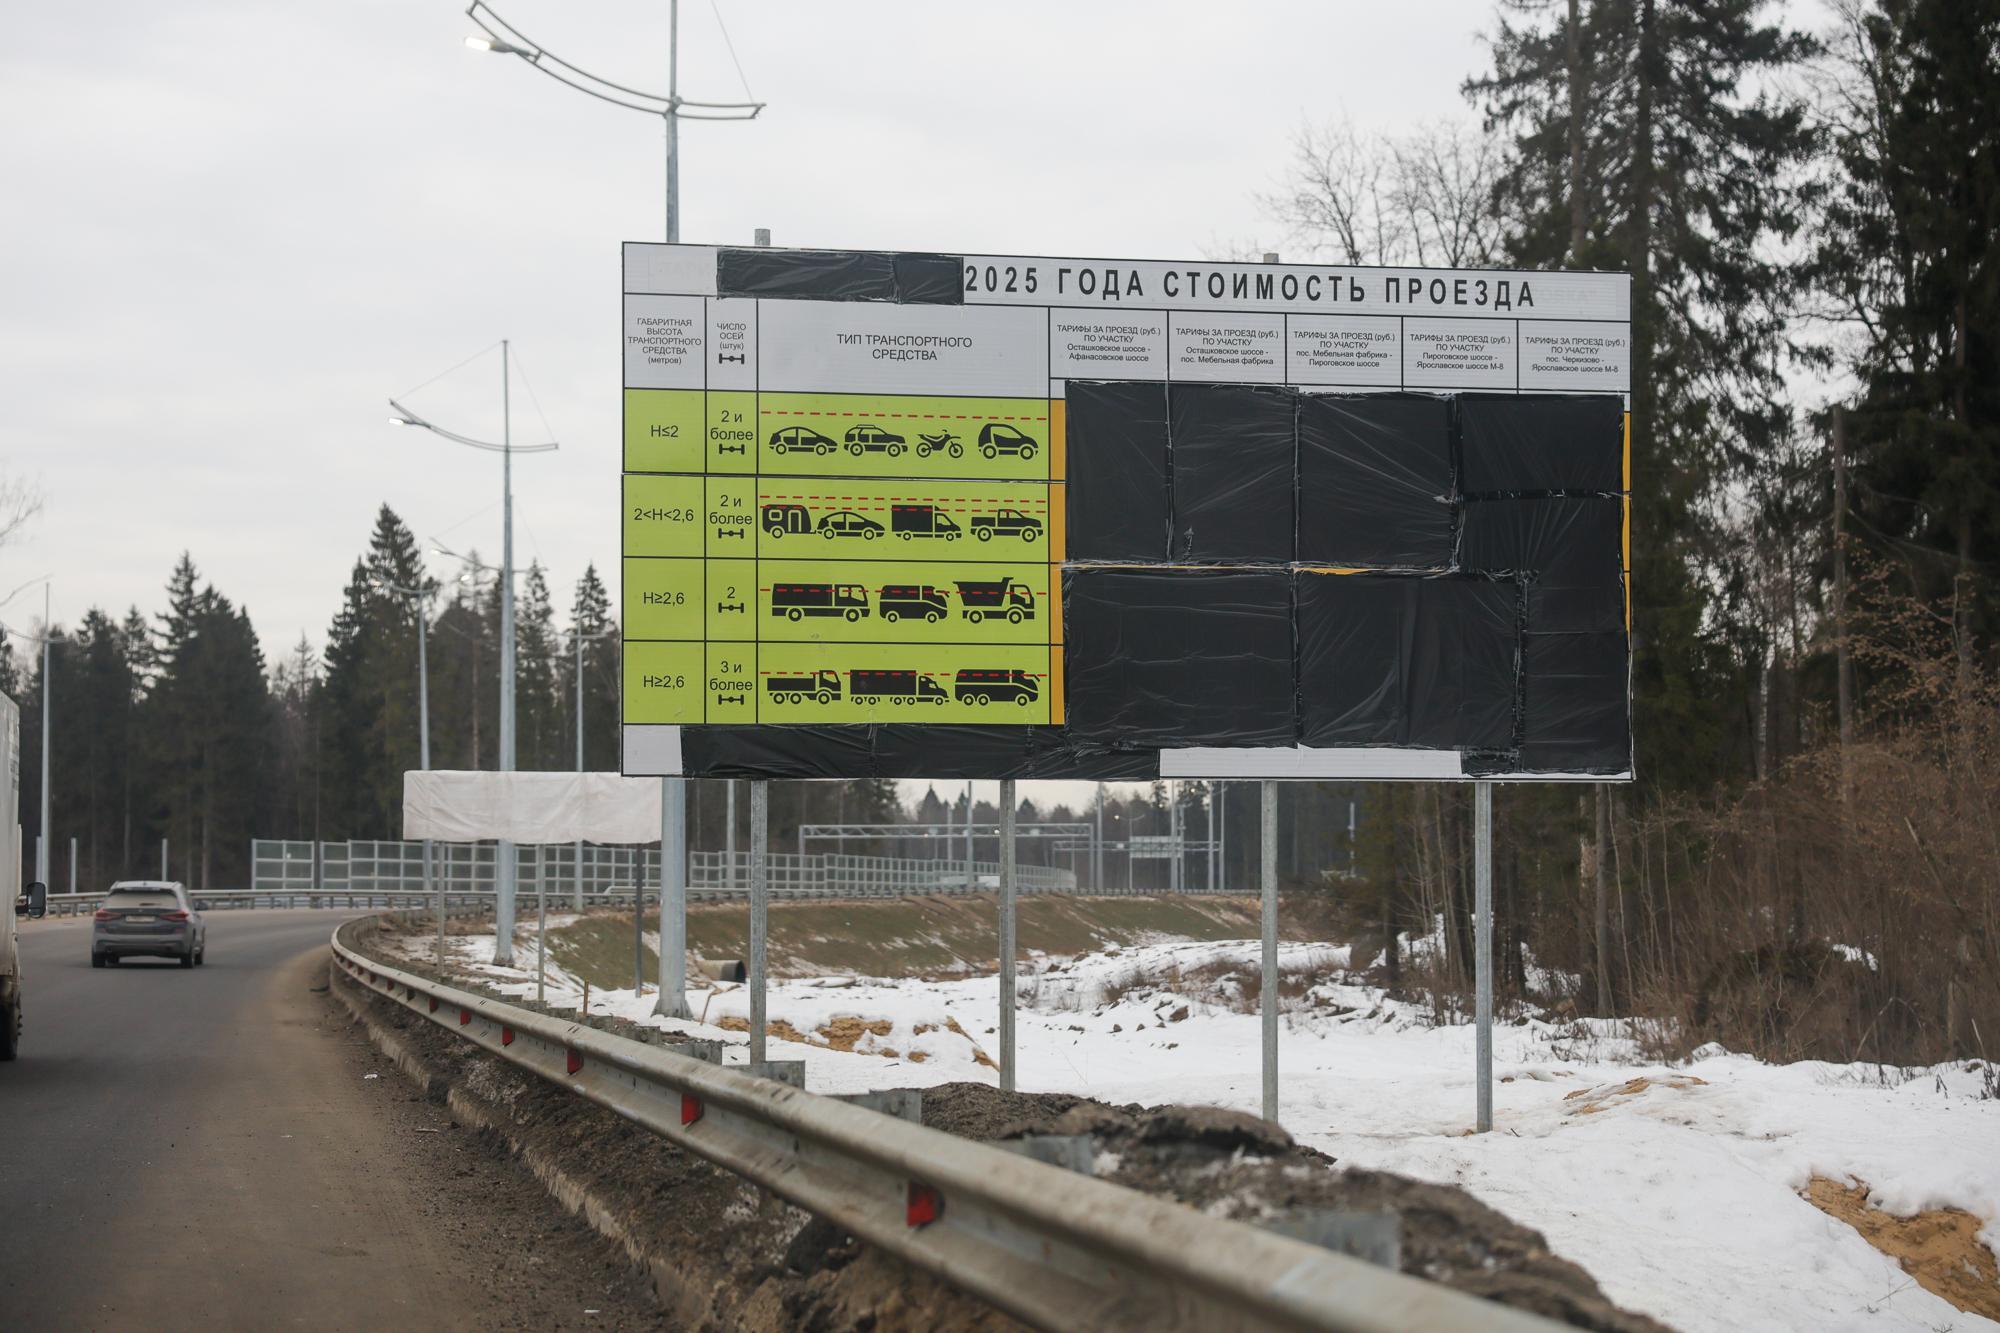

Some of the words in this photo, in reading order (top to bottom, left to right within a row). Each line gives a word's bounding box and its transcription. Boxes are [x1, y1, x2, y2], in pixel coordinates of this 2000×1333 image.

[965, 266, 1038, 293] 2025
[1058, 268, 1144, 301] ГОДА
[1163, 271, 1366, 302] СТОИМОСТЬ
[1385, 276, 1535, 310] ПРОЕЗДА
[637, 318, 692, 327] ГАБАРИТНАЯ
[717, 323, 746, 331] ЧИСЛО
[647, 327, 683, 336] ВЫСОТА
[1057, 325, 1091, 333] ТАРИФЫ
[1106, 326, 1138, 334] ПРОЕЗД
[1140, 327, 1160, 336] (руб.)
[1176, 328, 1210, 336] ТАРИФЫ
[1224, 330, 1256, 338] ПРОЕЗД
[1258, 331, 1279, 339] (руб.)
[720, 331, 743, 340] ОСЕЙ
[1099, 335, 1134, 343] УЧАСТКУ
[1410, 334, 1443, 342] ТАРИФЫ
[1457, 336, 1488, 344] ПРОЕЗД
[628, 337, 702, 346] ТРАНСПОРТНОГО
[837, 334, 862, 345] ТИП
[866, 335, 972, 348] ТРАНСПОРТНОГО
[1525, 337, 1558, 345] ТАРИФЫ
[1572, 338, 1603, 347] ПРОЕЗД
[1605, 339, 1625, 347] (руб.)
[642, 346, 687, 355] СРЕДСТВА
[719, 342, 744, 350] (штук)
[1067, 344, 1121, 353] Осташковское
[1186, 346, 1239, 355] Осташковское
[1450, 344, 1484, 352] УЧАСТКУ
[872, 349, 937, 362] СРЕДСТВА
[1566, 347, 1598, 355] УЧАСТКУ
[648, 355, 681, 365] (метров)
[1069, 353, 1123, 362] Афанасовское
[1198, 356, 1239, 364] Мебельная
[1242, 358, 1273, 366] фабрика
[1423, 353, 1468, 361] Пироговское
[1562, 356, 1599, 364] Черкизово
[1417, 362, 1464, 371] Ярославское
[1532, 364, 1579, 373] Ярославское
[721, 411, 730, 423] 2
[734, 414, 742, 423] и
[710, 428, 753, 441] более
[721, 495, 729, 507] 2
[734, 498, 741, 507] и
[710, 512, 752, 524] более
[727, 587, 735, 599] 2
[721, 661, 729, 673] 3
[734, 664, 742, 673] и
[710, 678, 753, 690] более
